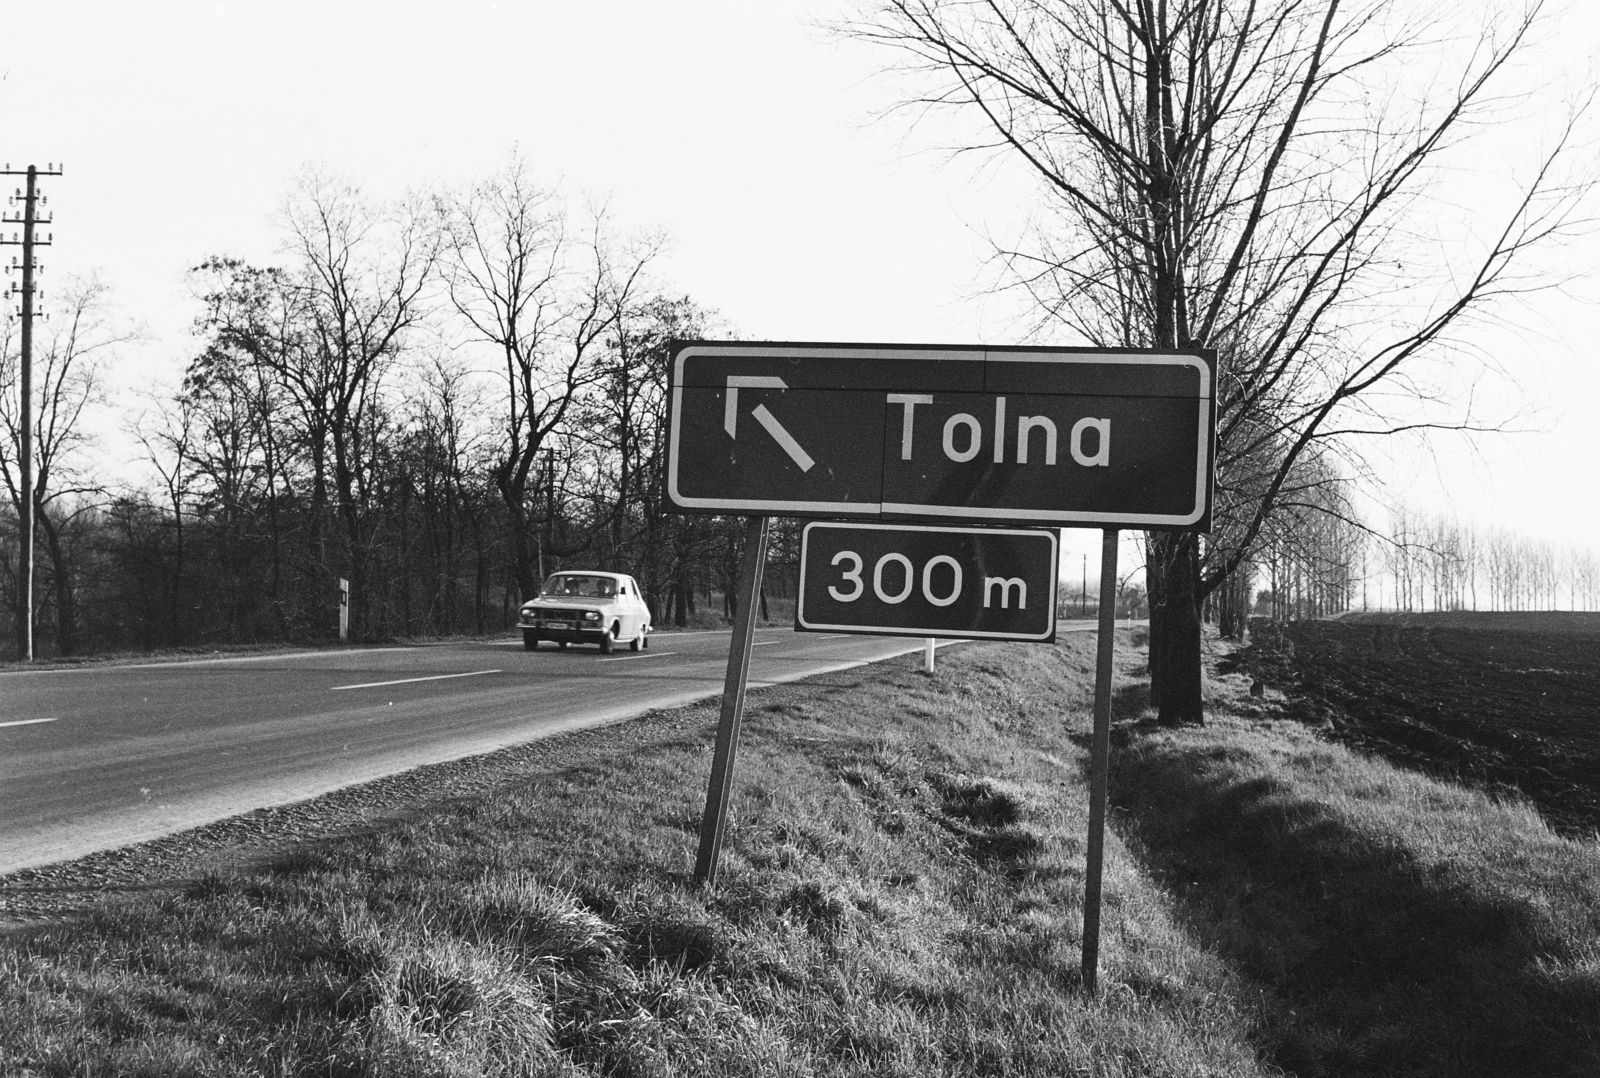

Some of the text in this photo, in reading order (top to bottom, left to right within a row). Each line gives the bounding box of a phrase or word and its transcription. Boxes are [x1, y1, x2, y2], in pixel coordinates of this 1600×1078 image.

[886, 393, 1111, 467] Tolna
[827, 550, 1027, 610] 300 m
